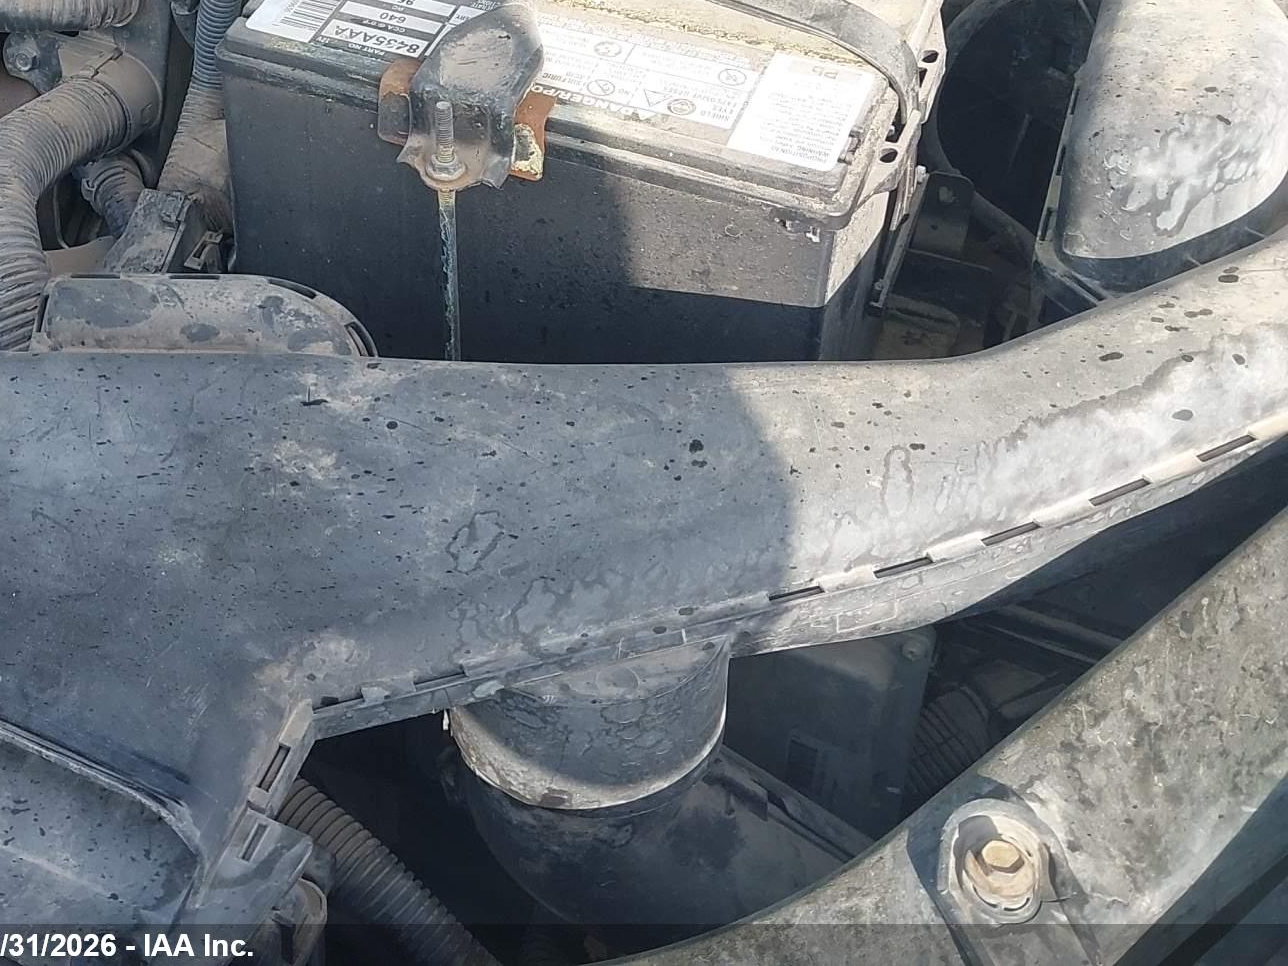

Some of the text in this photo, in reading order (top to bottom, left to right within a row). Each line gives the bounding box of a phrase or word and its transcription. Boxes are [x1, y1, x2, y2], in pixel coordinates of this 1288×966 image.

[380, 12, 406, 24] 640
[388, 24, 406, 33] CCA
[335, 25, 420, 54] 8435AAA
[367, 47, 386, 56] PART
